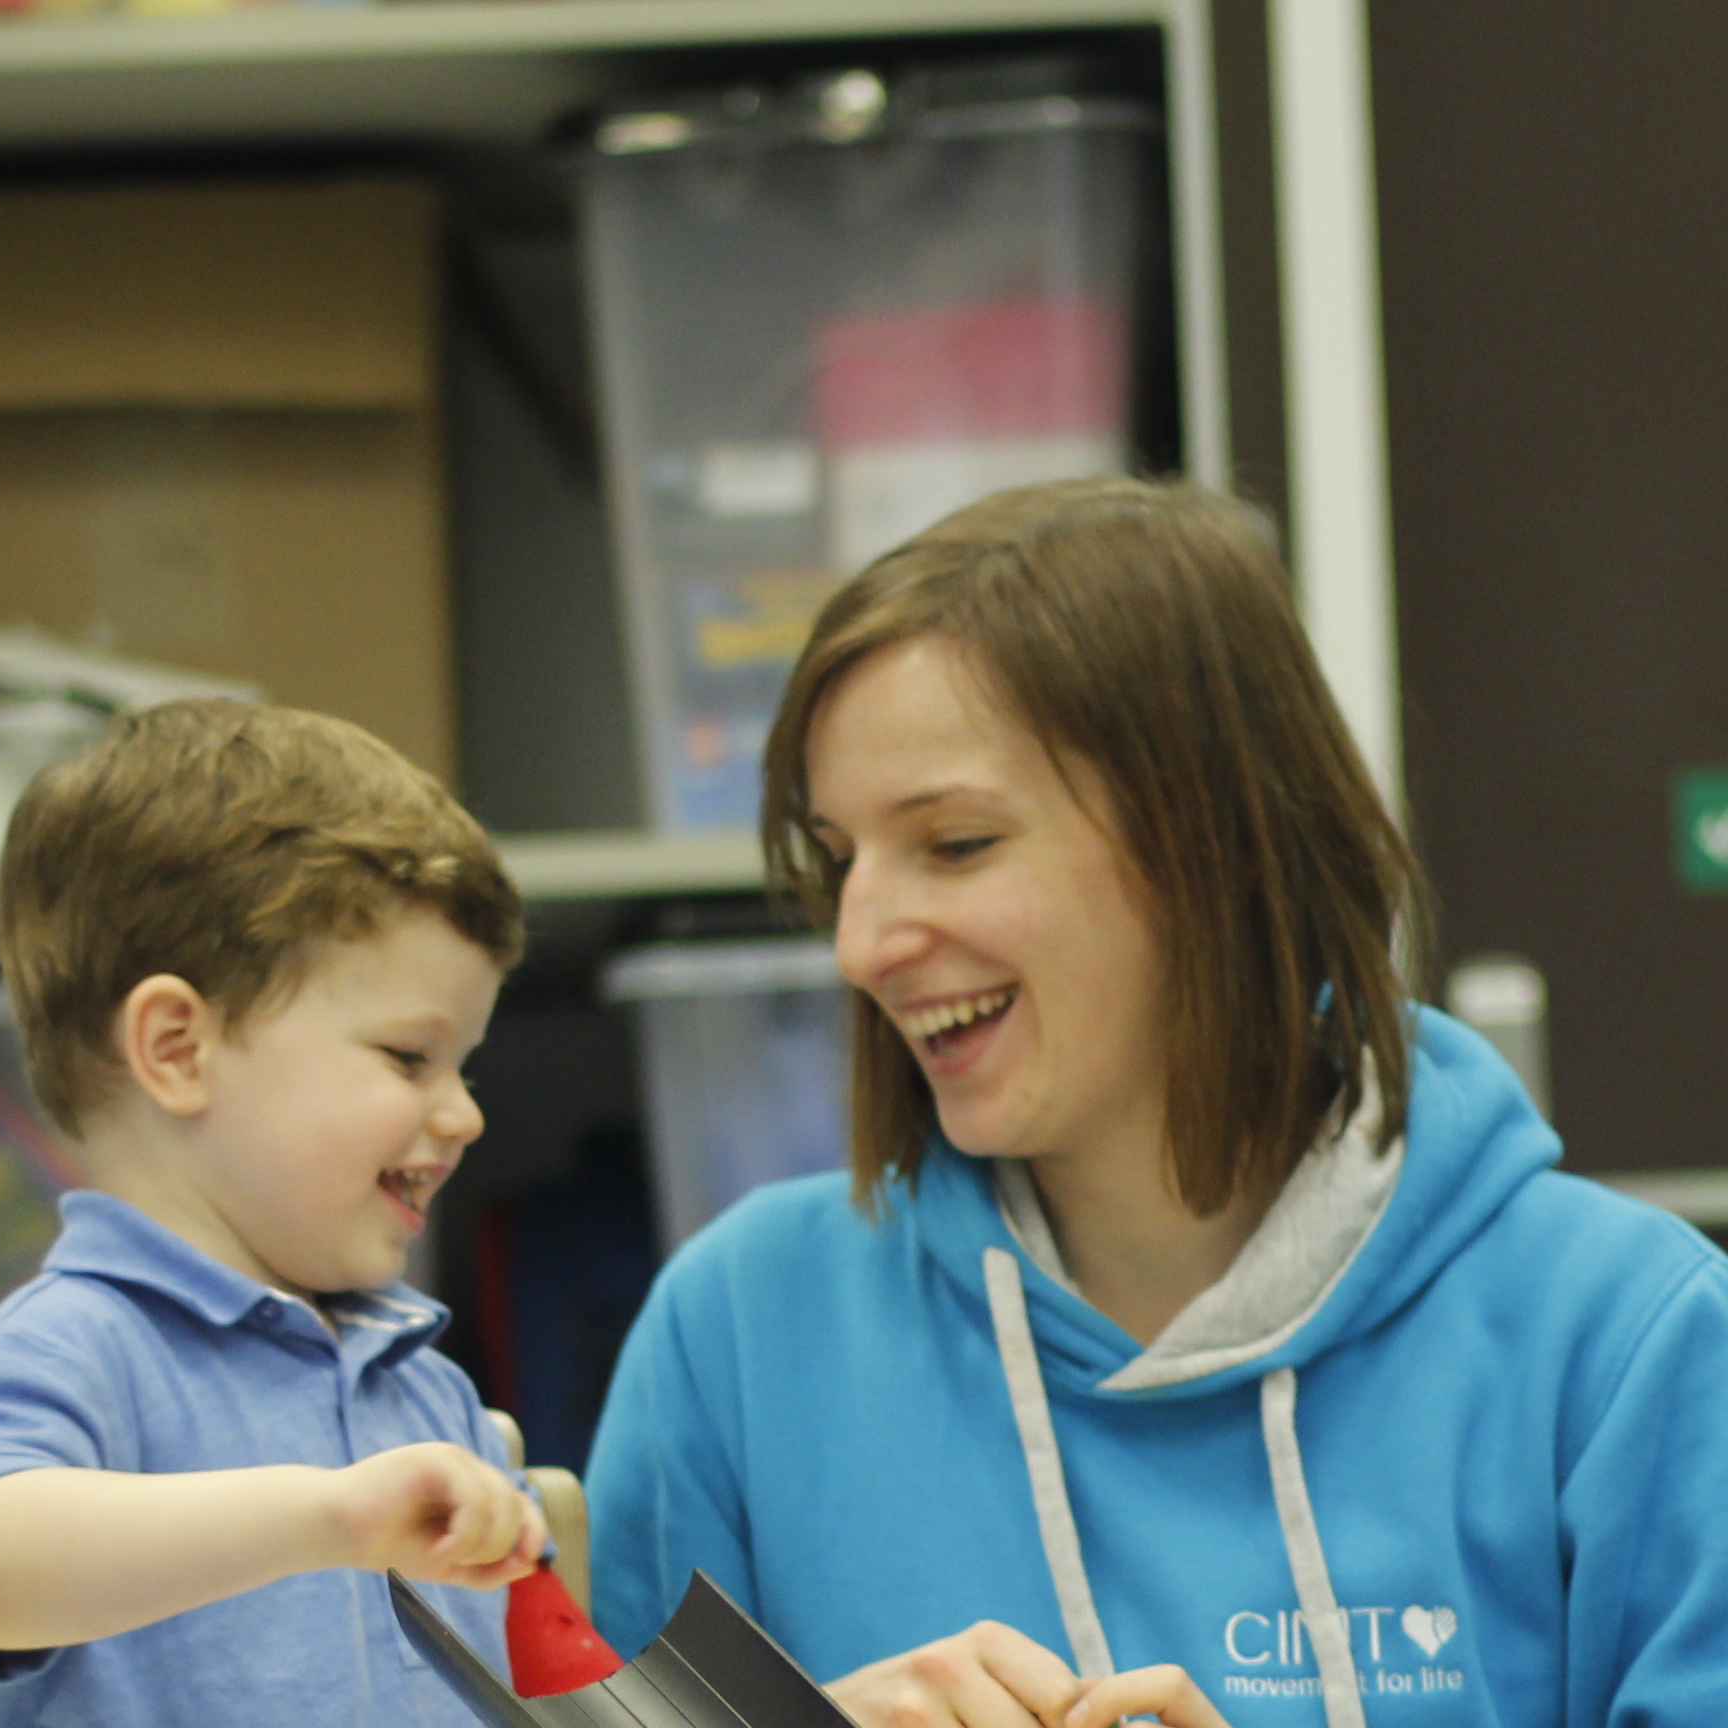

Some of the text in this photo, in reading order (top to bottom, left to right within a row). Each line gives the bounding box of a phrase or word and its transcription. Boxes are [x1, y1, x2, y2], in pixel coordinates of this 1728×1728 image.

[1224, 1665, 1464, 1697] movemt for life
